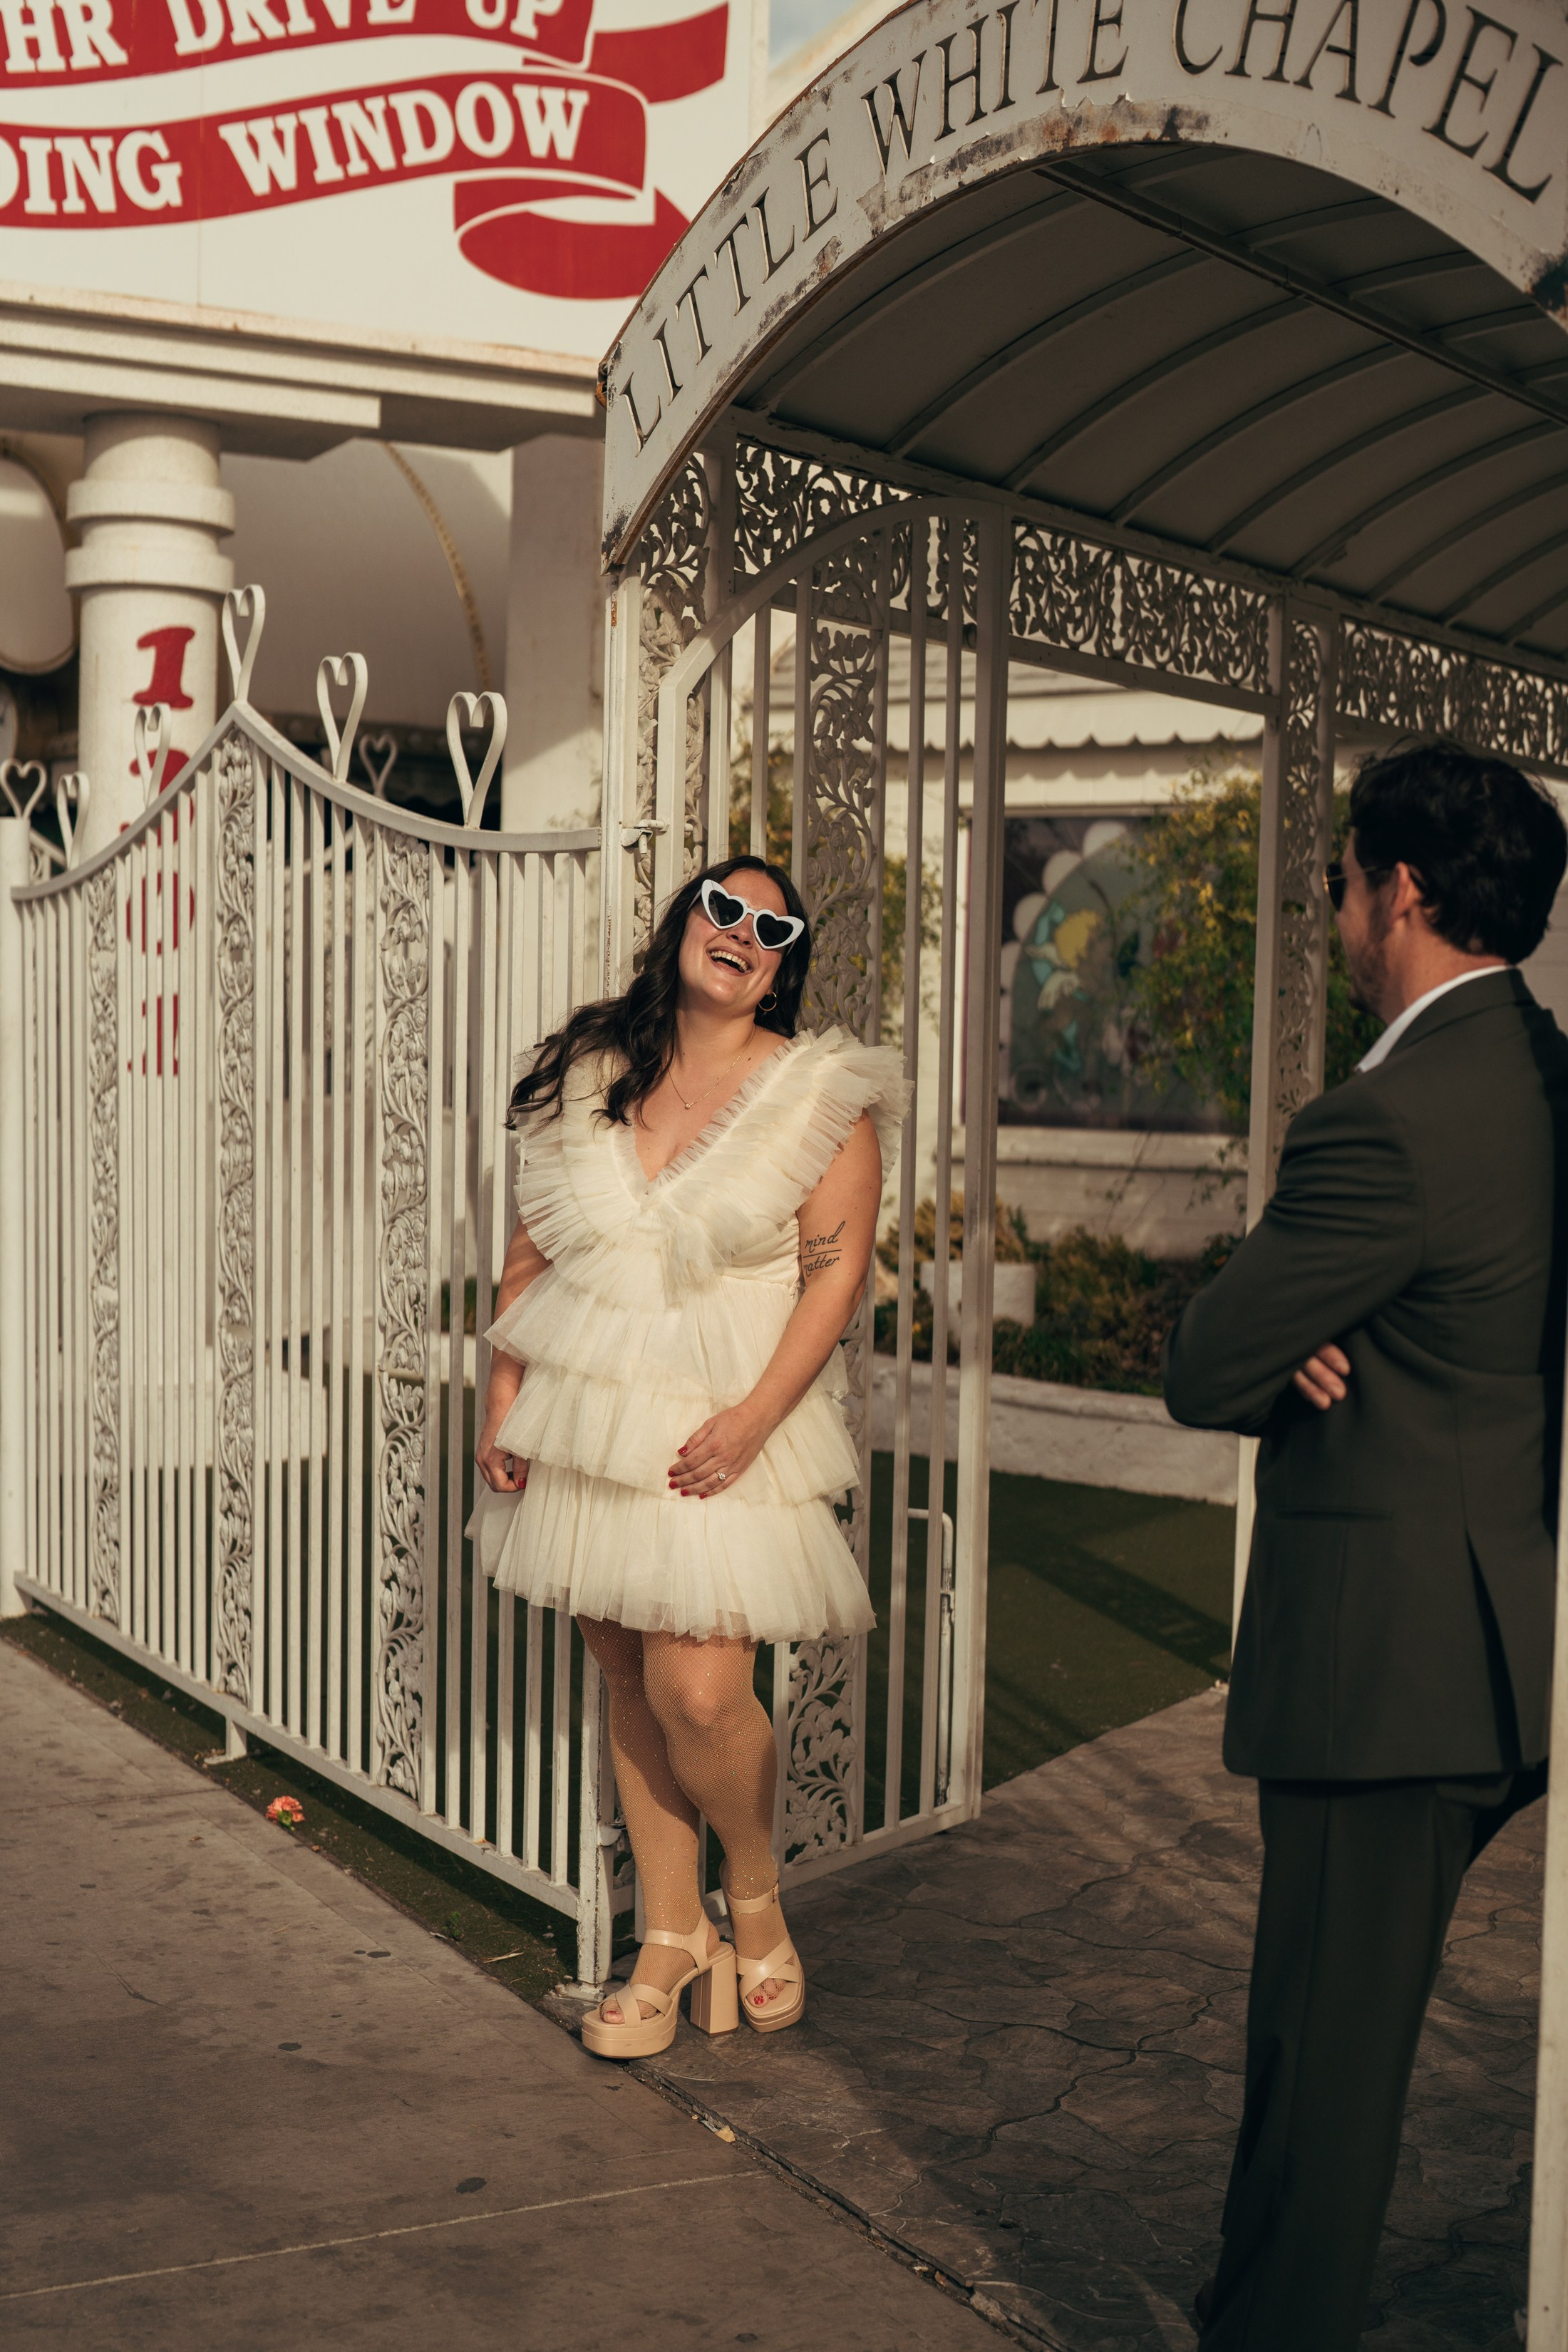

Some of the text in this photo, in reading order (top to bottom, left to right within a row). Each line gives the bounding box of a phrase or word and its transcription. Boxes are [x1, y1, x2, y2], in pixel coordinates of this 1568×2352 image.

[218, 81, 589, 196] WINDOW
[619, 0, 1564, 458] LITTLE WHITE CHAPEL
[805, 1220, 846, 1254] mind
